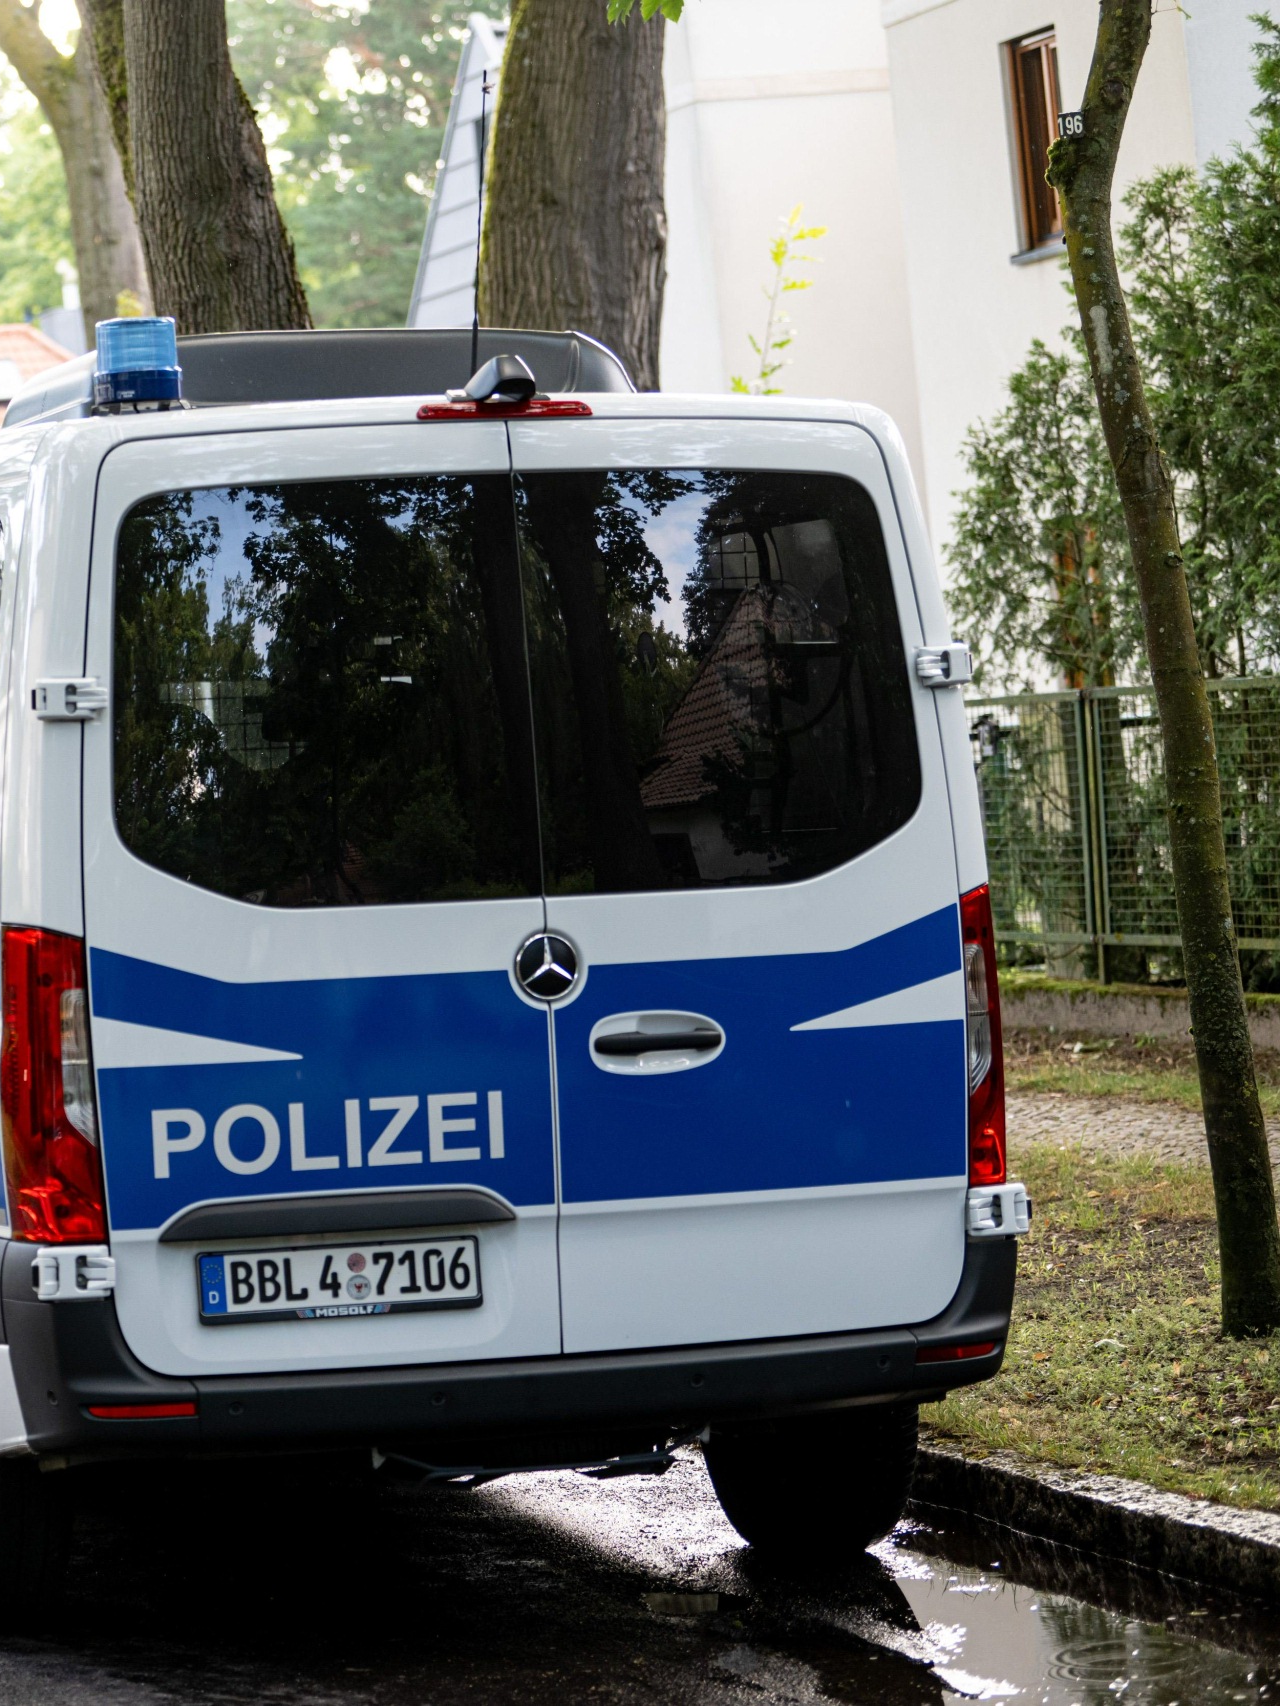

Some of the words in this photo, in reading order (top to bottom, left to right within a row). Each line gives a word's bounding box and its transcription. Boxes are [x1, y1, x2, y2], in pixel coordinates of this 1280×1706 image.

[1058, 115, 1083, 136] 196
[151, 1090, 505, 1179] POLIZEI
[230, 1257, 309, 1305] BBL
[372, 1246, 471, 1296] 7106
[208, 1291, 220, 1304] D
[315, 1305, 374, 1318] MOSOLF
